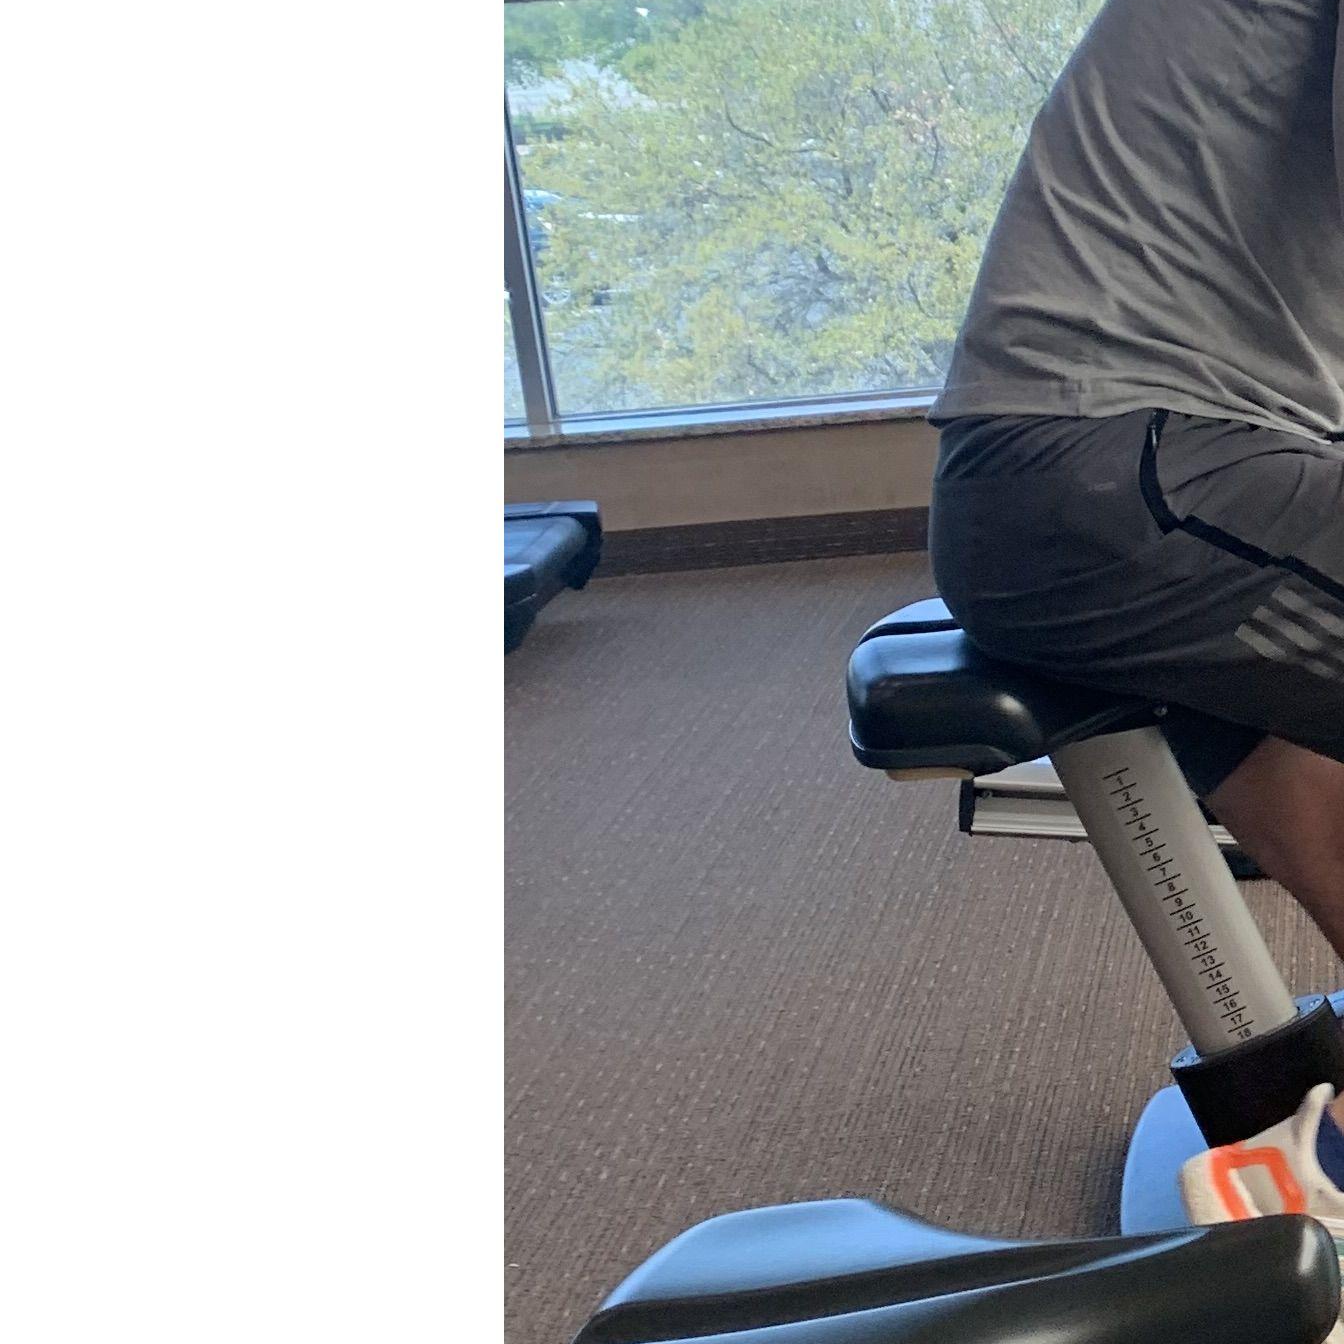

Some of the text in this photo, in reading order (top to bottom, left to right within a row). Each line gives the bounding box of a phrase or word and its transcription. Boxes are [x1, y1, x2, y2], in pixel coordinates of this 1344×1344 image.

[1117, 776, 1123, 785] 1
[1122, 792, 1131, 802] 2
[1130, 807, 1139, 816] 3
[1139, 821, 1146, 831] 4
[1144, 837, 1153, 847] 5
[1152, 852, 1161, 861] 6
[1160, 868, 1166, 876] 7
[1167, 882, 1175, 891] 8
[1174, 897, 1183, 906] 9
[1179, 911, 1193, 922] 10
[1187, 925, 1200, 937] 11
[1194, 940, 1208, 951] 12
[1201, 955, 1215, 967] 13
[1208, 969, 1222, 982] 14
[1215, 984, 1230, 996] 15
[1223, 999, 1237, 1011] 16
[1230, 1013, 1243, 1025] 17
